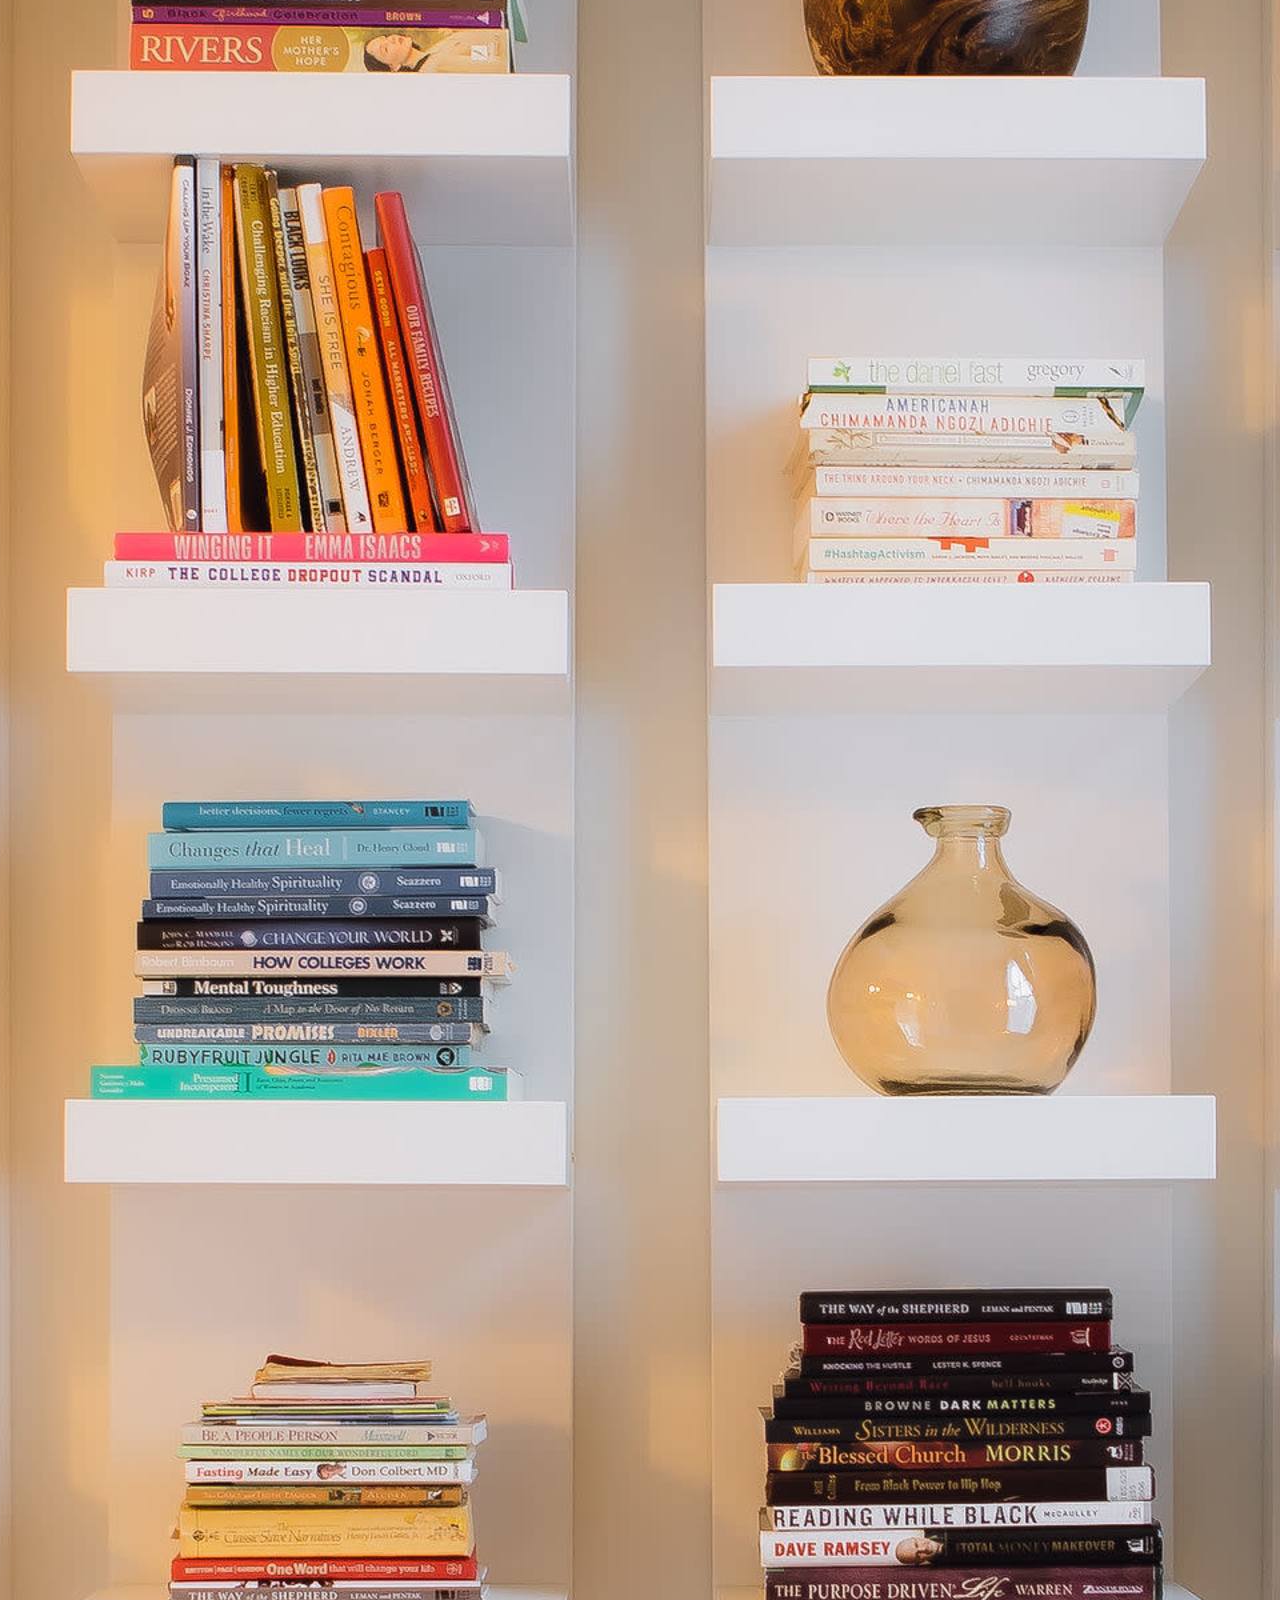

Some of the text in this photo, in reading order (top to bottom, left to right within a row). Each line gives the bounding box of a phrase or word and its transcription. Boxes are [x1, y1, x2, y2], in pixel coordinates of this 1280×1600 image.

[141, 36, 263, 64] RIVERS
[886, 398, 990, 413] AMERICANAH
[820, 413, 1052, 432] CHIMAMANDA NGOZI ADICHIE
[174, 535, 272, 560] WINGING IT
[305, 534, 421, 560] EMMA ISAACS
[168, 567, 441, 583] THE COLLEGE DROPOUT SCANDAL
[254, 956, 425, 971] HOW COLLEGES WORK
[152, 1049, 320, 1066] RUBYFRUIT JUNGLE
[196, 1467, 313, 1479] Fasting Made Easy
[774, 1506, 1038, 1527] READING WHILE BLACK
[774, 1540, 890, 1558] DAVE RAMSEY
